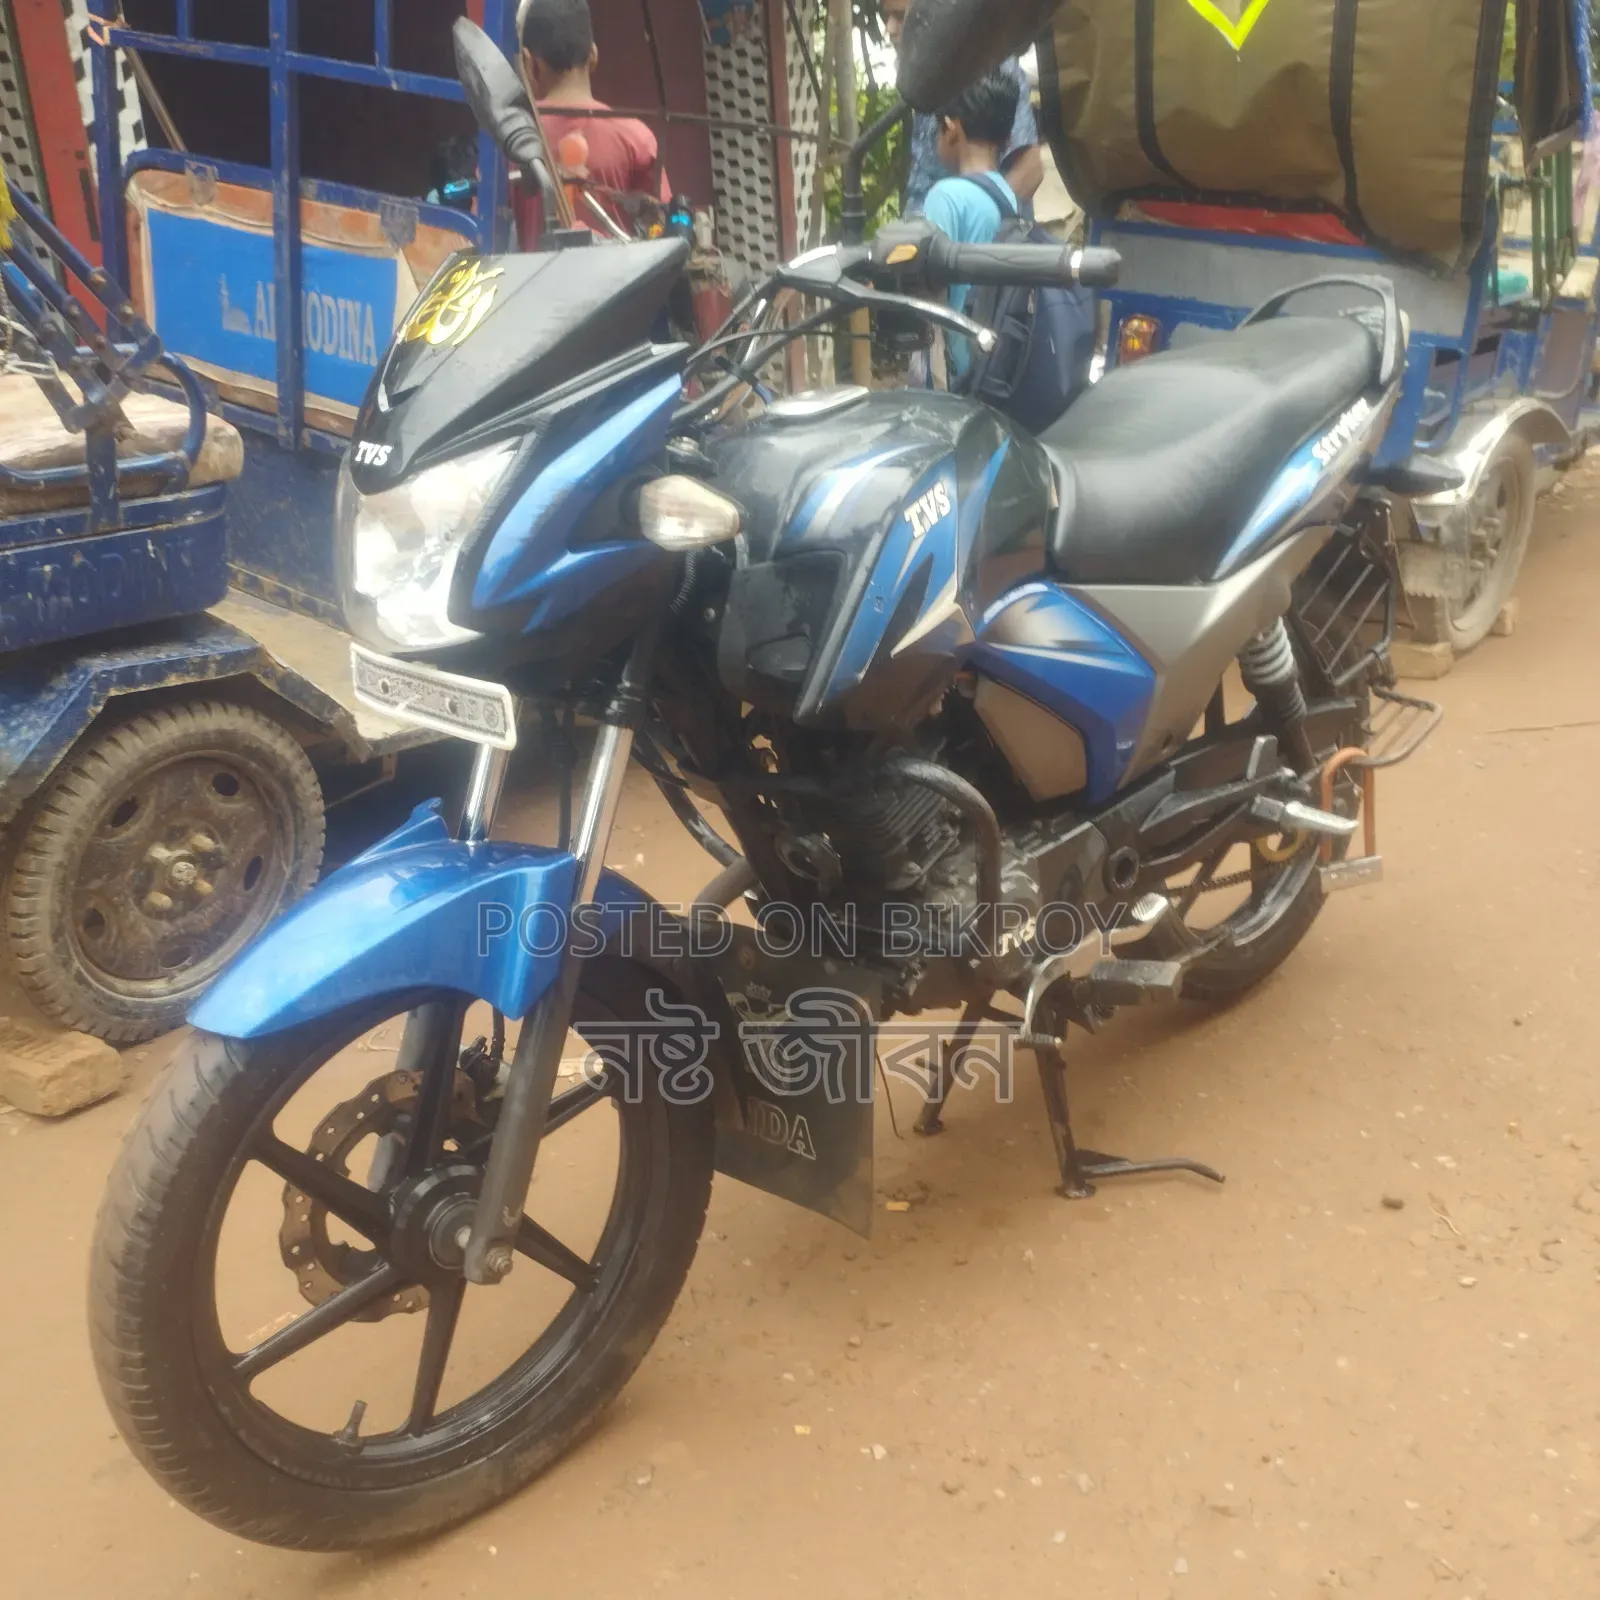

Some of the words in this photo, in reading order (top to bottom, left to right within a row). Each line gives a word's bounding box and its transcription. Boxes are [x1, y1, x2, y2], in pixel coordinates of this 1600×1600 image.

[301, 289, 379, 368] ODINA
[355, 440, 393, 466] TVS
[903, 480, 951, 538] TVS
